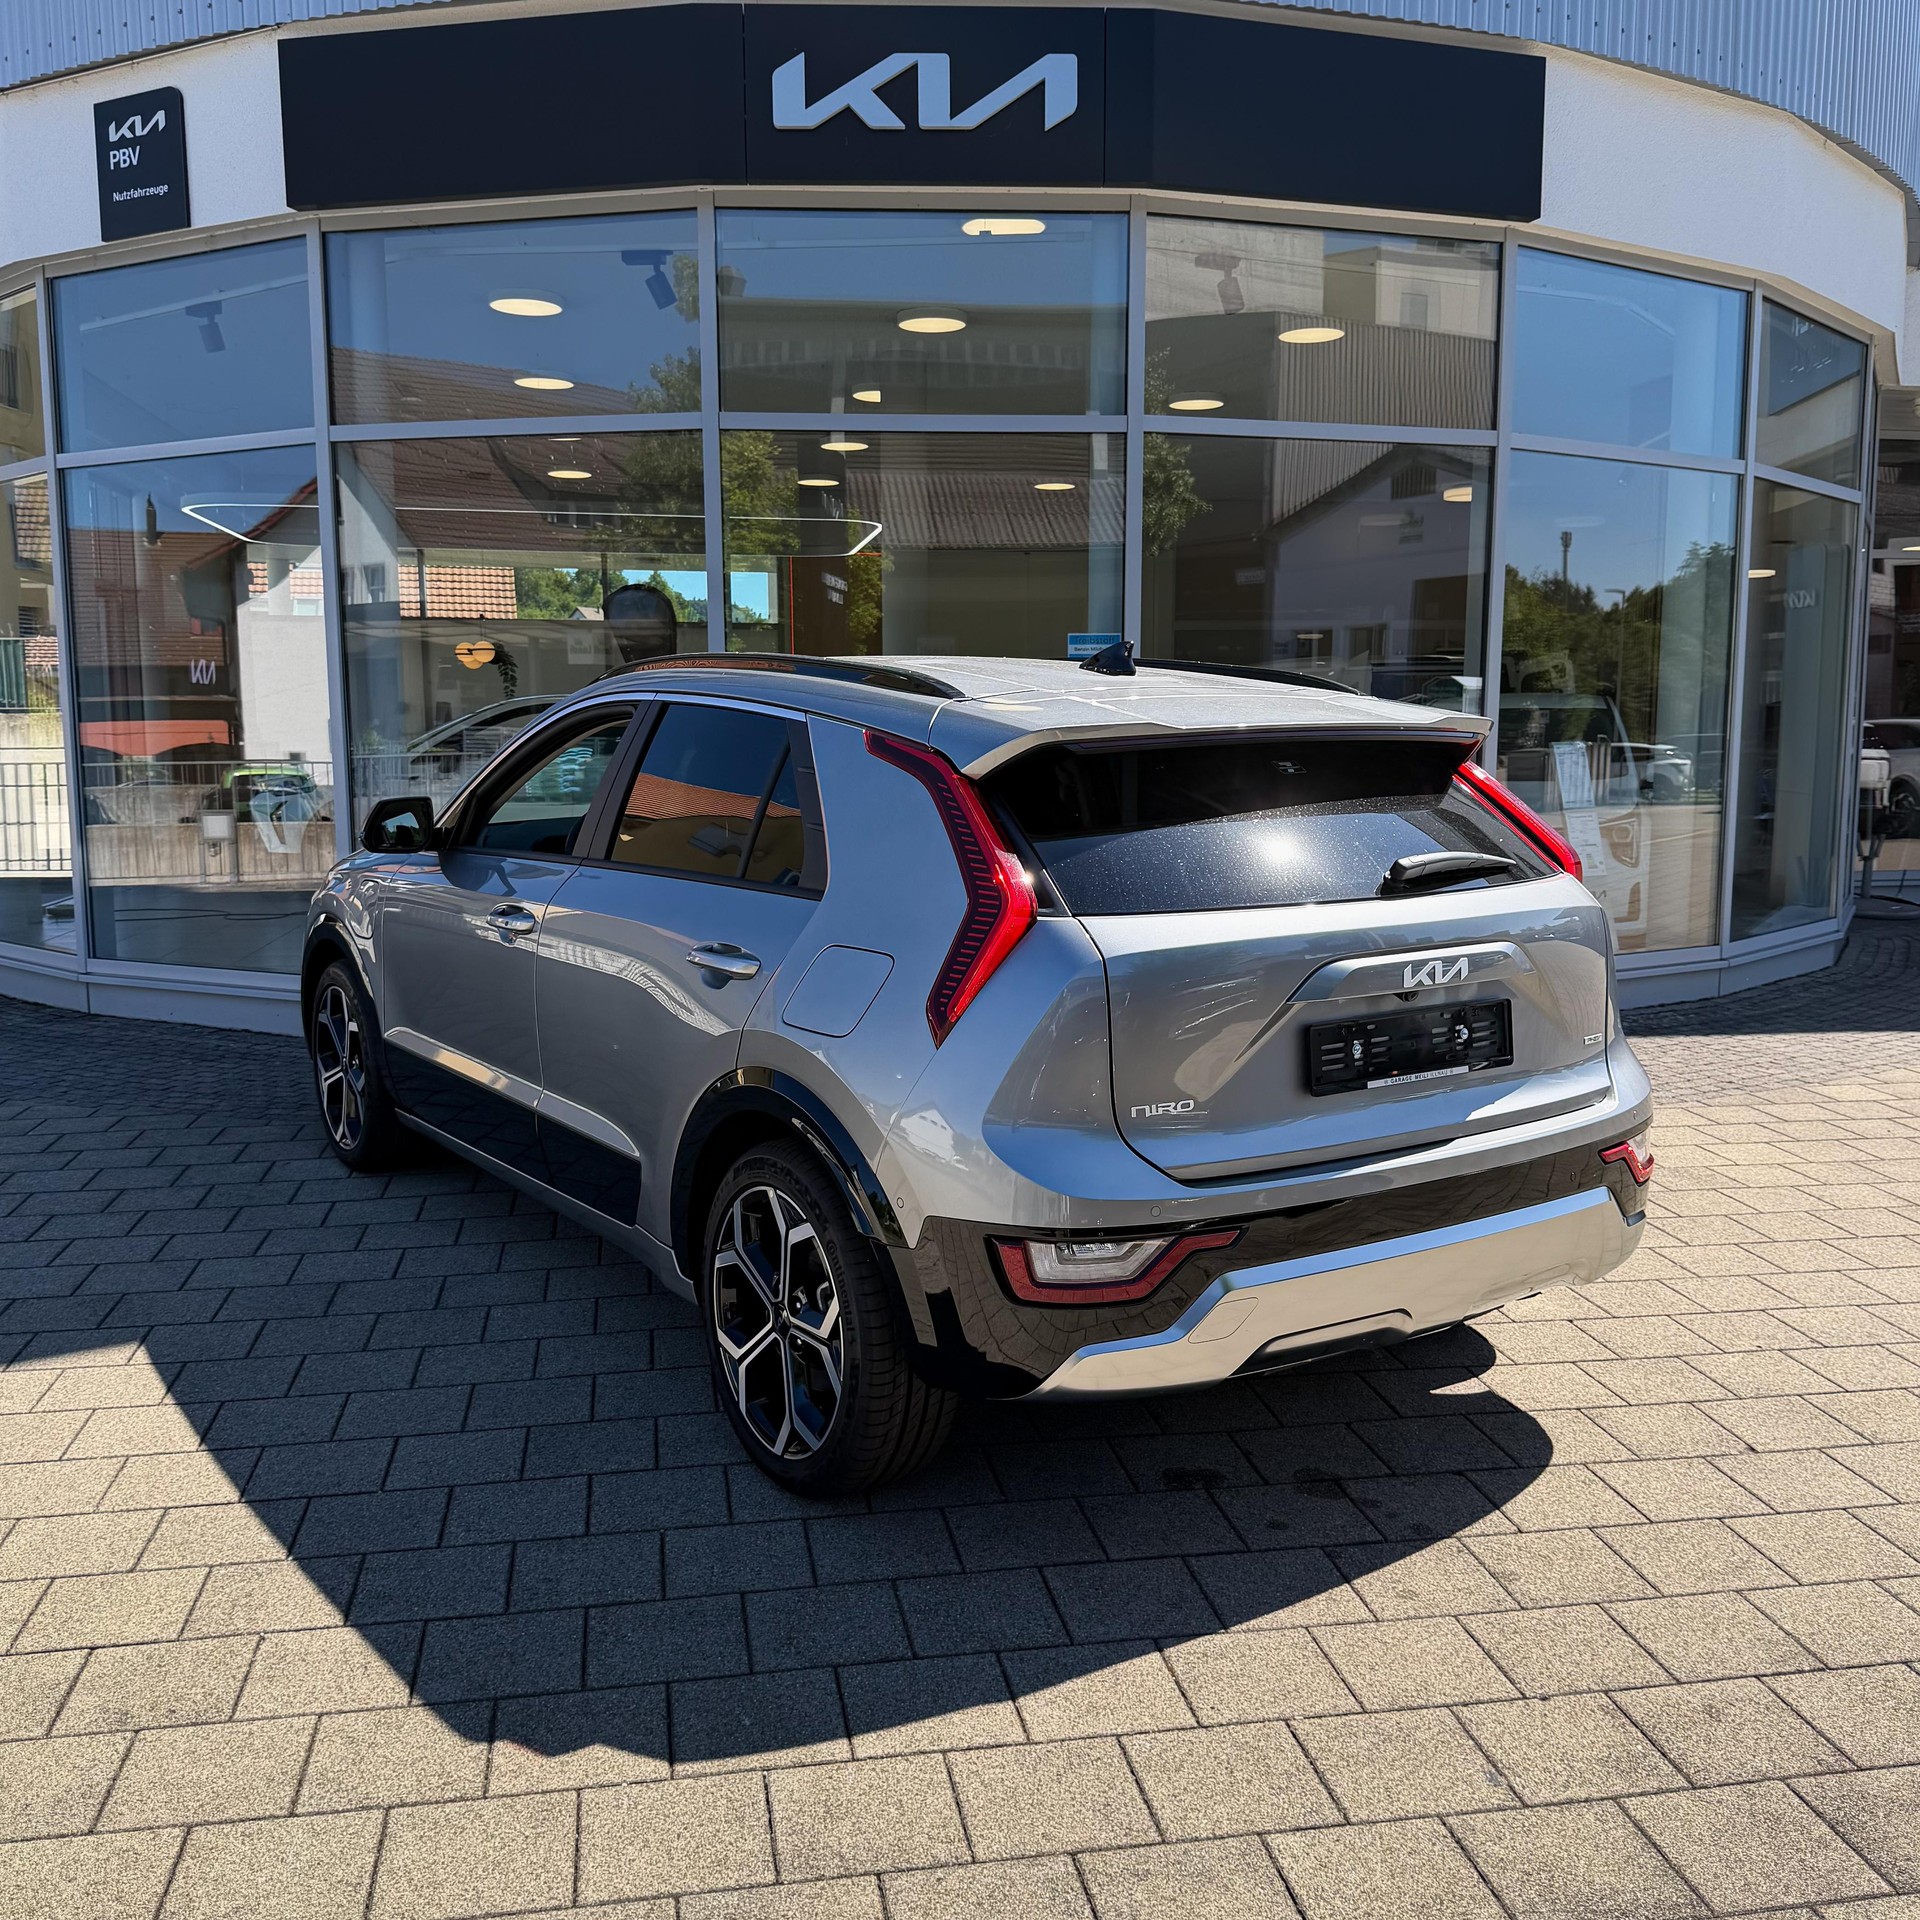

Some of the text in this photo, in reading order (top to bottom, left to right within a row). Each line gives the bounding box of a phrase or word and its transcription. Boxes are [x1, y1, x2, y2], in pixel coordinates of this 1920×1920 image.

[772, 52, 1078, 132] KIA
[109, 109, 165, 142] KIA
[110, 145, 140, 170] PBV
[113, 184, 168, 202] Nutzfahrzeuge
[1404, 957, 1469, 988] KIA
